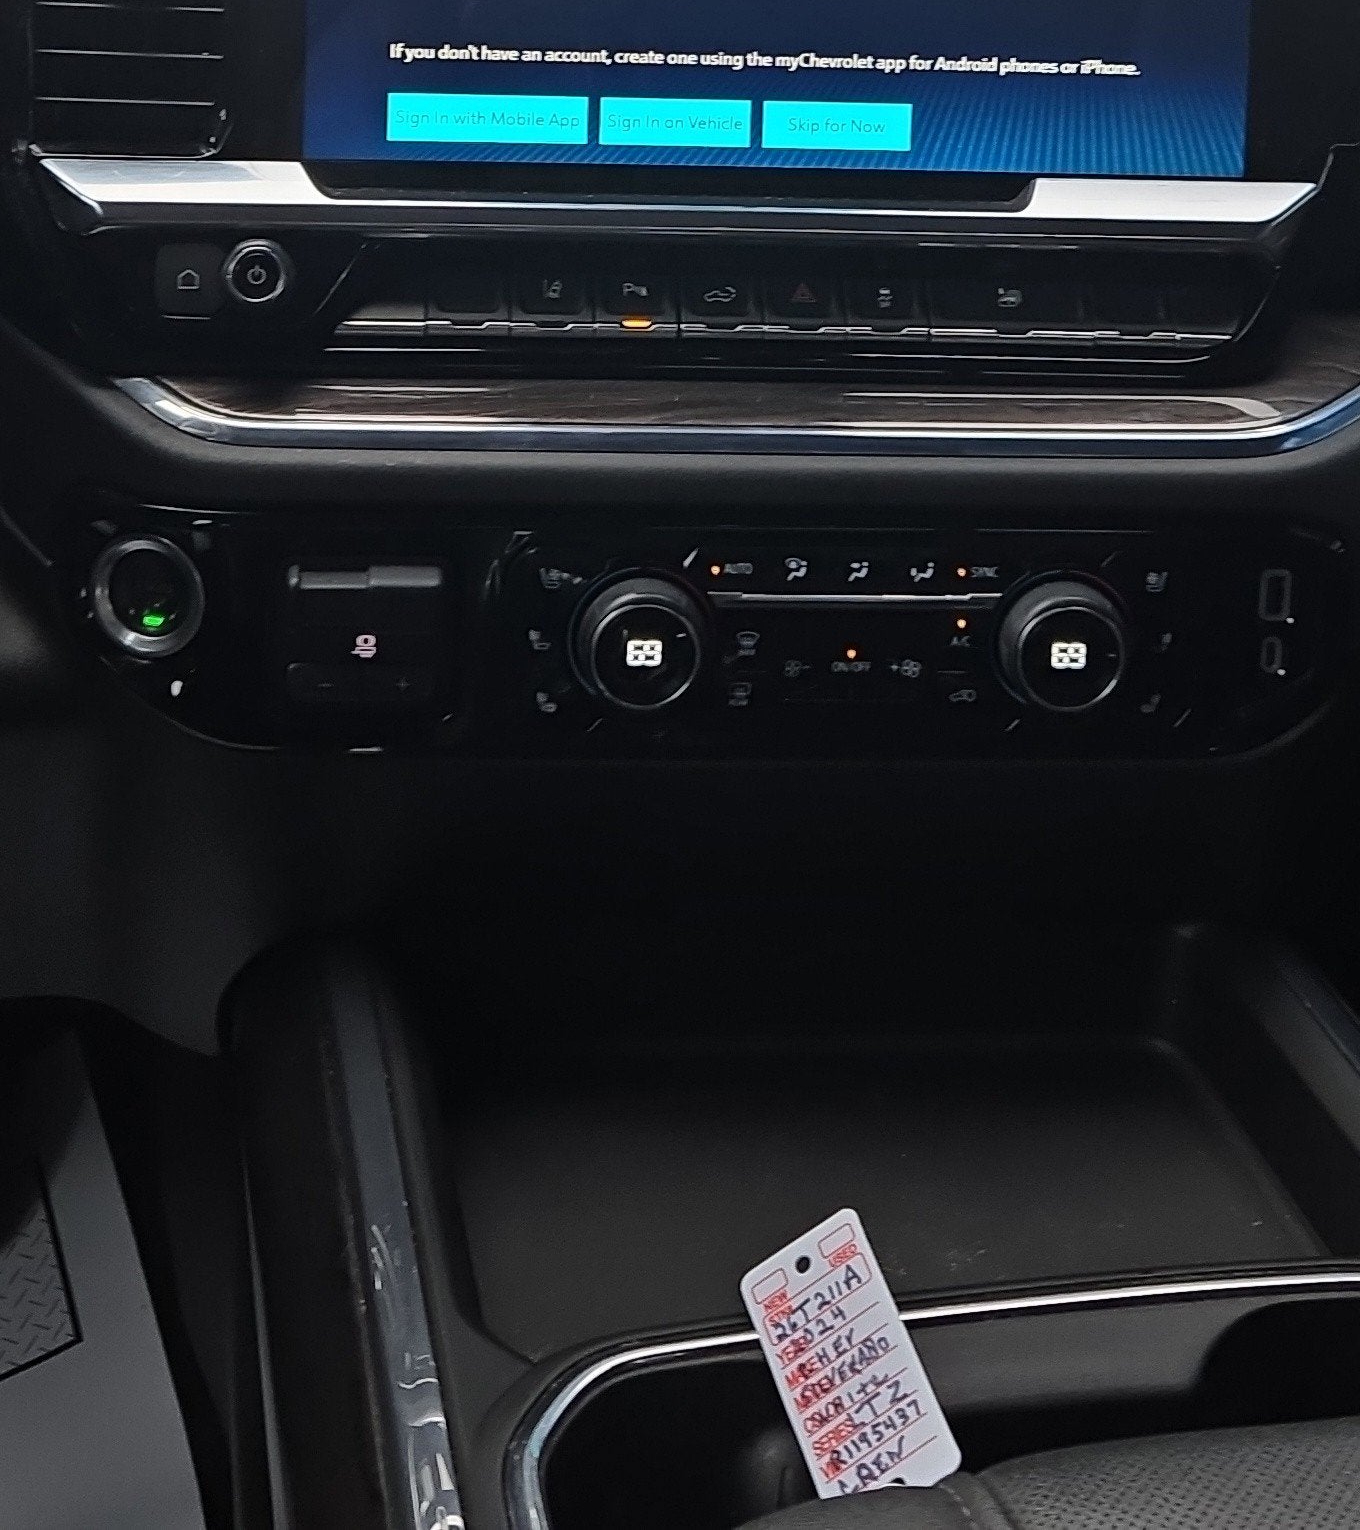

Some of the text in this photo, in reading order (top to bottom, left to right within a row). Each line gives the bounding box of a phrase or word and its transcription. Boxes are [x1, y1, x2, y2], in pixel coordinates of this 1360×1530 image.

[389, 43, 1141, 76] If you don't have an account, create one using the myChevrolet app for Android phones or iPhone.
[395, 110, 580, 129] Sign In with Mobile App
[607, 114, 743, 130] Sign In on Vehicle
[788, 118, 885, 134] Skip for Now
